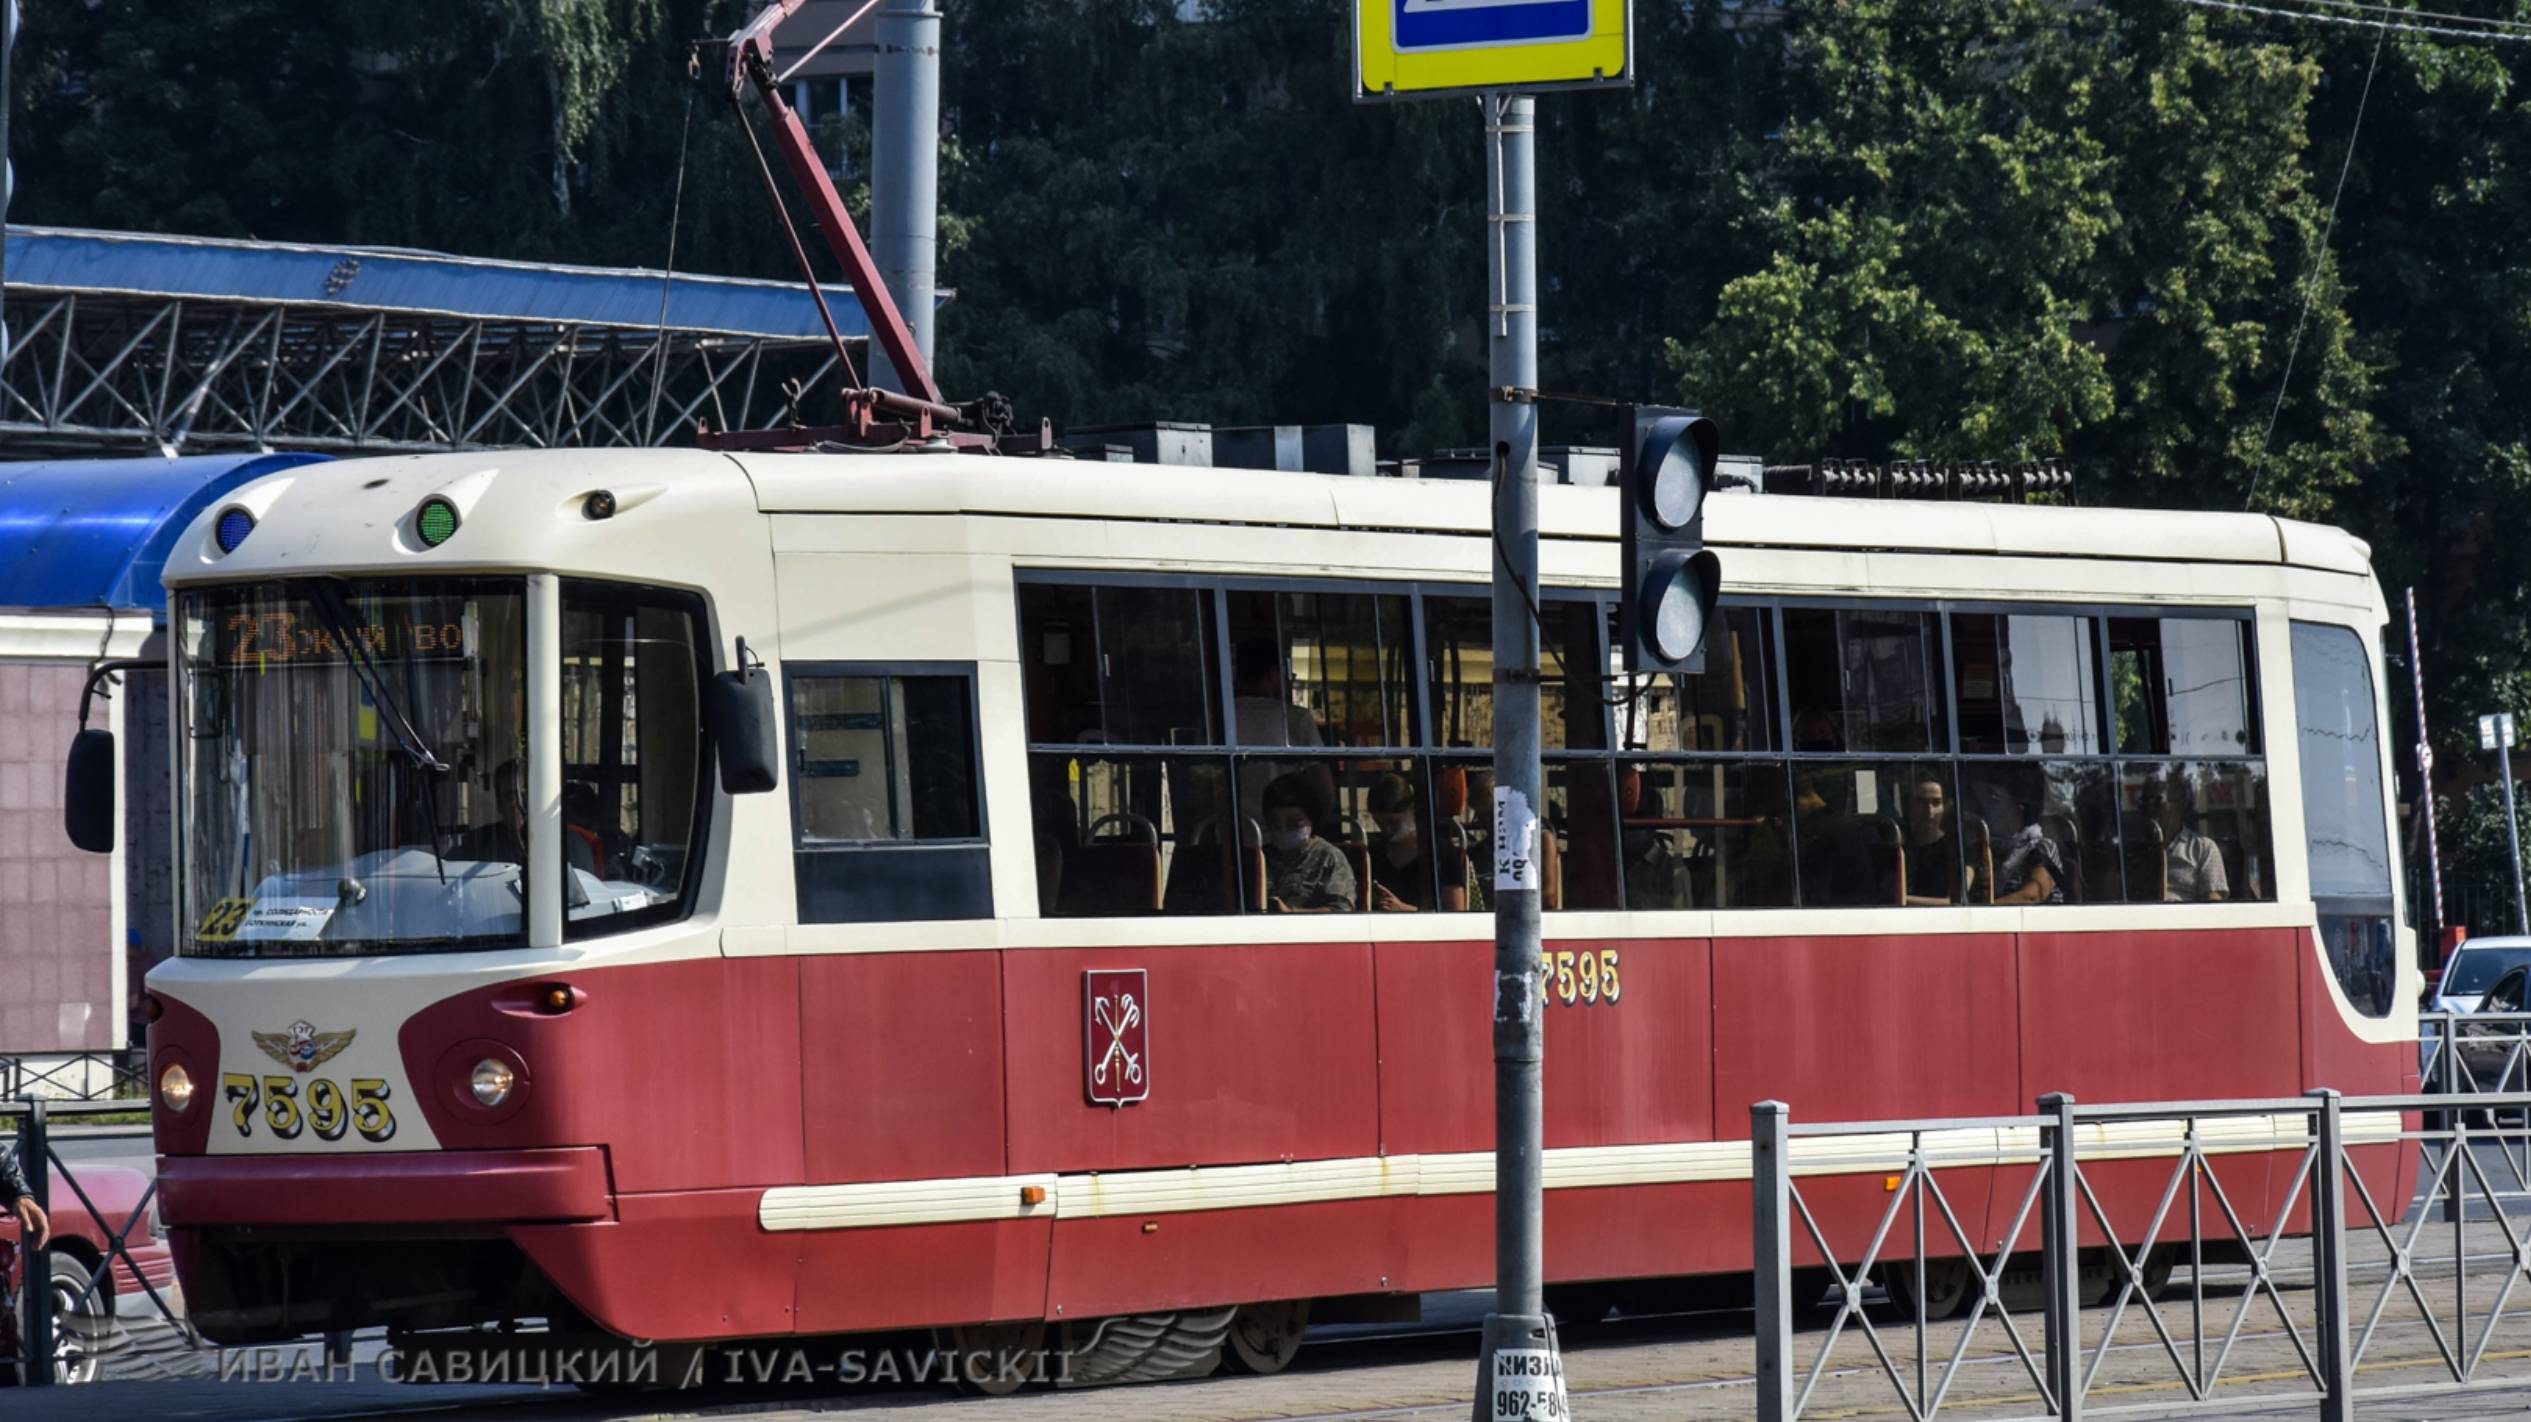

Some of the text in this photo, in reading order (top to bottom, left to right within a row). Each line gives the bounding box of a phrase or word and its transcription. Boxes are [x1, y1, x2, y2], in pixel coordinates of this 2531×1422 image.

[228, 611, 296, 662] 23
[200, 901, 251, 935] 23
[1541, 949, 1620, 1007] 7595
[222, 1071, 397, 1143] 7595
